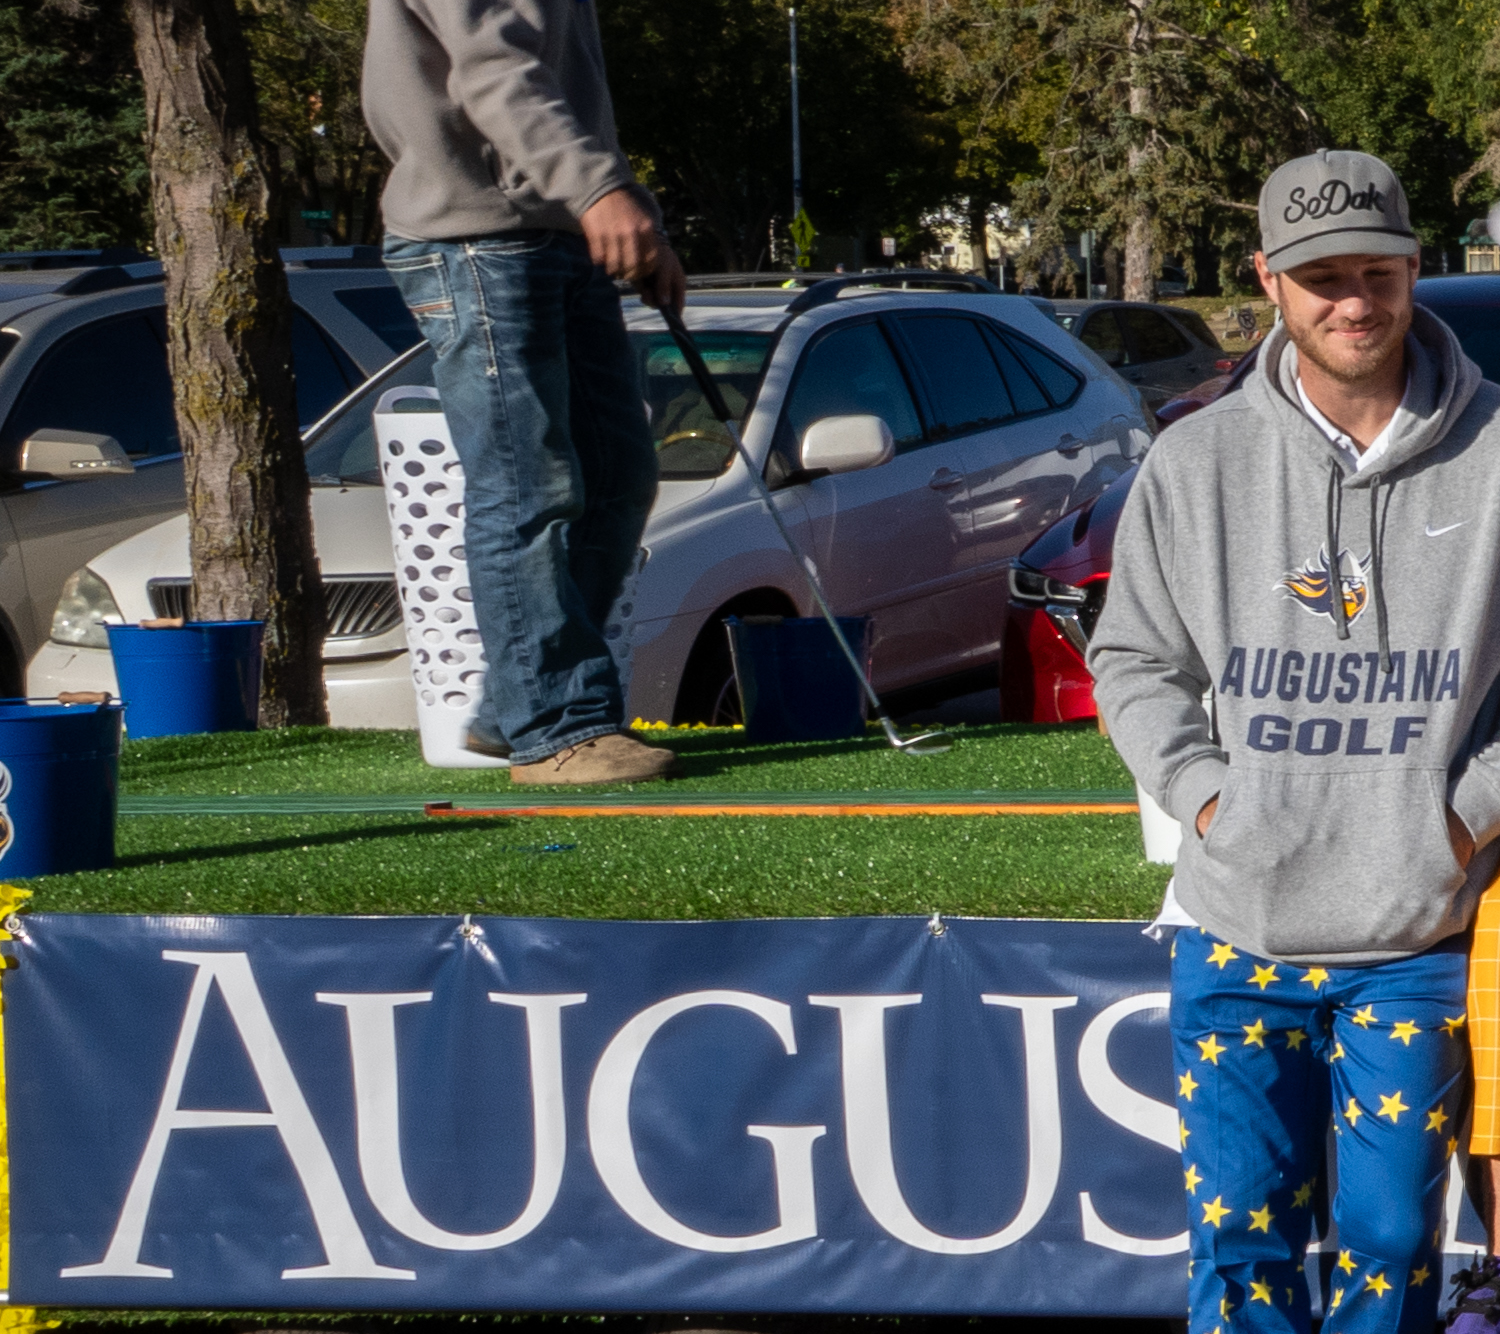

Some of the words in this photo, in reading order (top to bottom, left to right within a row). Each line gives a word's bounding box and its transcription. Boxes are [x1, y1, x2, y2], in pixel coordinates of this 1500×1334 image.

[1284, 179, 1385, 223] SoDak
[1219, 646, 1461, 704] AUGUSTANA
[1246, 714, 1428, 756] GOLF
